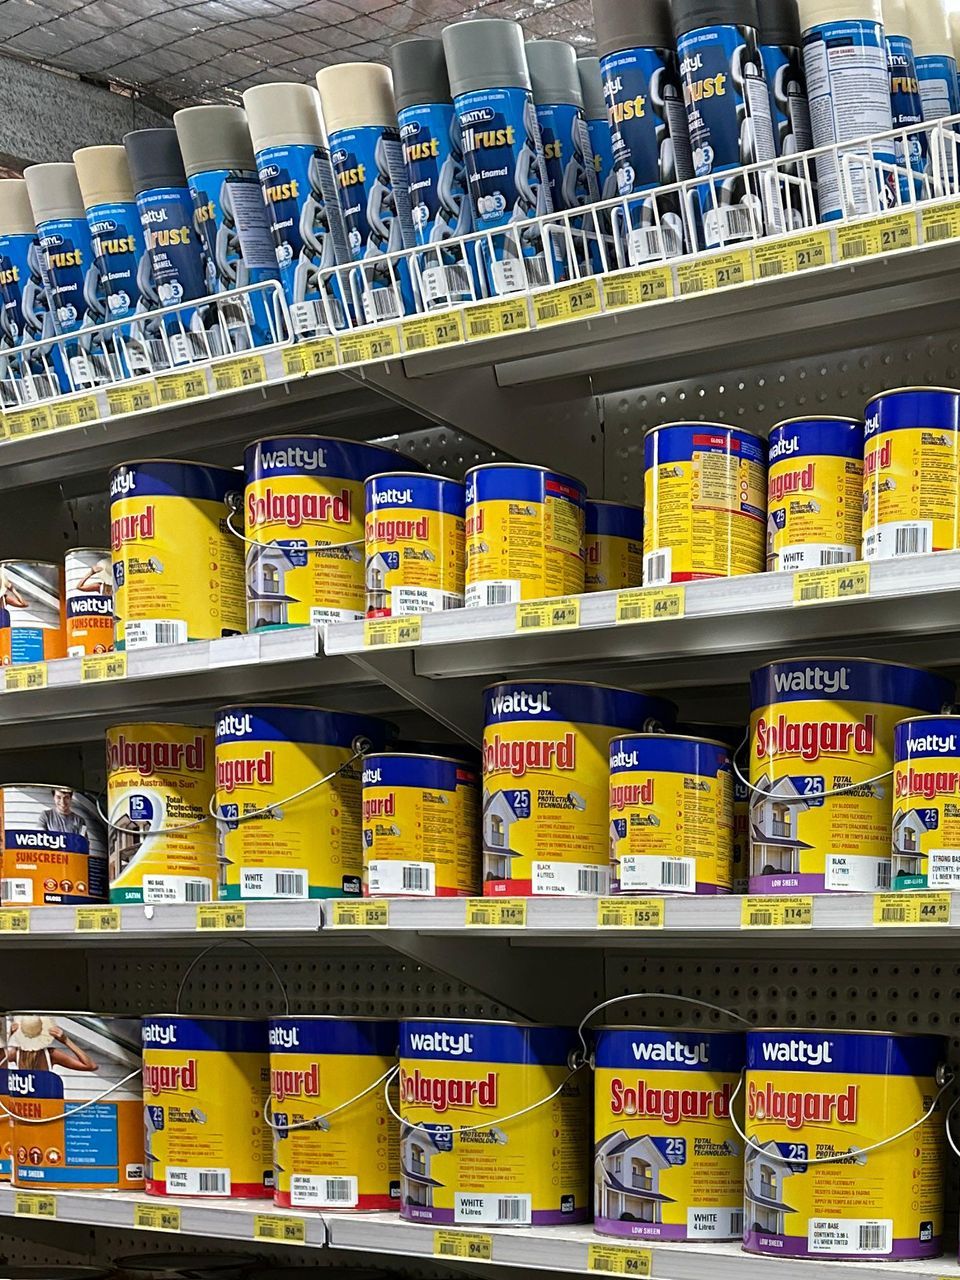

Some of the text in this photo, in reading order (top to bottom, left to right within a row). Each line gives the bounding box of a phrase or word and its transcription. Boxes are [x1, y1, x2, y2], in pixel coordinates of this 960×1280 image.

[260, 447, 326, 470] wattyl
[248, 488, 351, 528] Solagard
[783, 552, 804, 563] WHITE
[774, 667, 849, 692] wattyl
[491, 690, 550, 716] wattyl
[757, 714, 874, 761] Solagard
[907, 735, 956, 753] wattyl
[15, 832, 66, 849] wattyl
[15, 851, 69, 865] SUNSCREEN
[244, 873, 264, 883] WHITE
[45, 894, 62, 902] GLOSS
[410, 1033, 472, 1055] wattyl
[632, 1041, 708, 1065] wattyl
[762, 1040, 832, 1065] wattyl
[400, 1069, 497, 1113] Solagard
[611, 1079, 733, 1125] Solagard
[749, 1082, 857, 1129] Solagard
[170, 1172, 188, 1181] WHITE
[461, 1198, 484, 1208] WHITE
[694, 1212, 718, 1223] WHITE
[631, 1226, 661, 1236] LOW SHEEN
